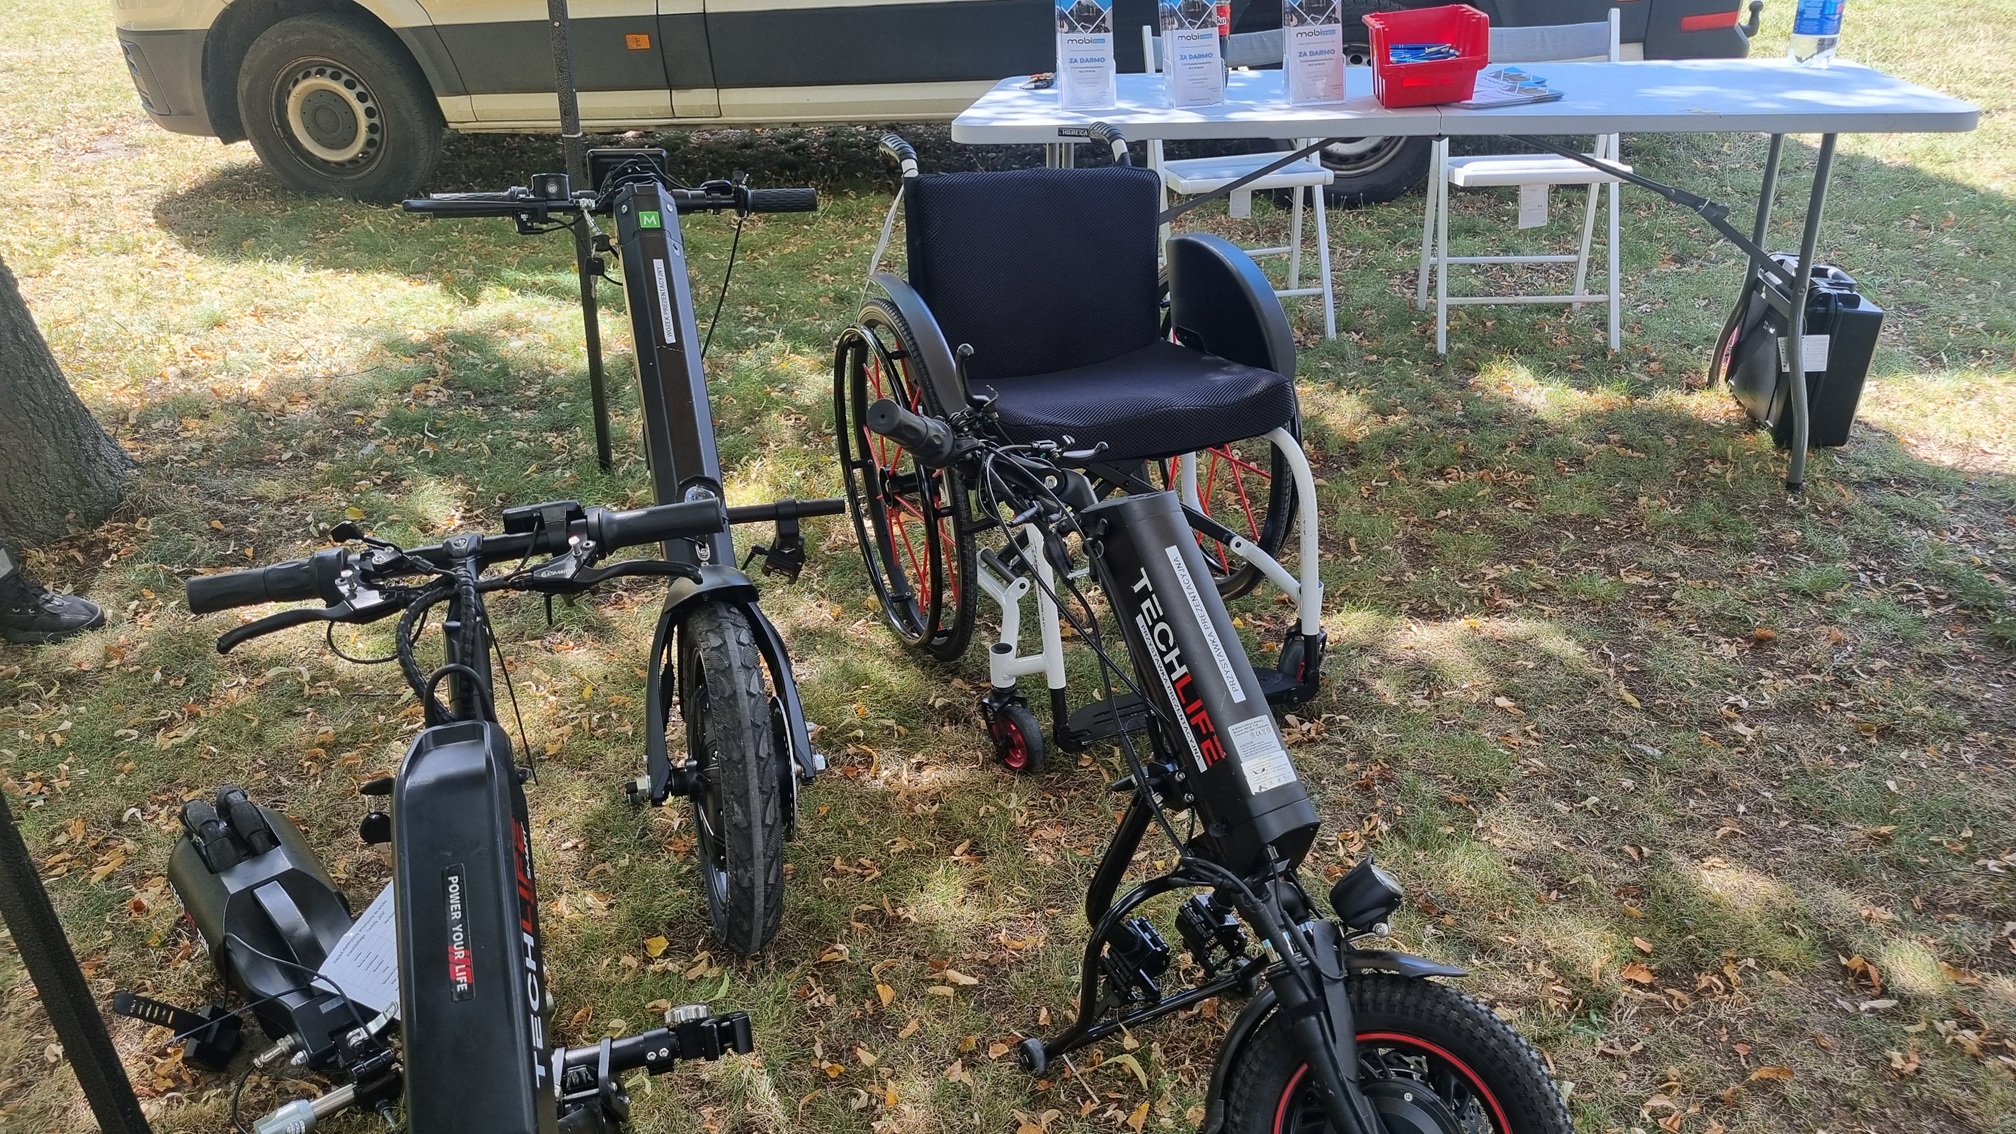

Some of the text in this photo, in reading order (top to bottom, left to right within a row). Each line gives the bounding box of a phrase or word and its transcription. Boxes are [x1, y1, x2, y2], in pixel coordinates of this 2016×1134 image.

[1189, 52, 1213, 60] DARMO
[1309, 49, 1336, 57] DARMO
[643, 215, 657, 225] M
[1131, 567, 1226, 766] TECHLIFE
[1173, 556, 1239, 693] PRZYSTAWKA PREZENTACYJNA
[1141, 624, 1201, 762] PRZYSTAWKA PREZENTACYJNA
[448, 875, 468, 992] POWER YOUR LIFE
[512, 817, 546, 1089] TECHLIFE
